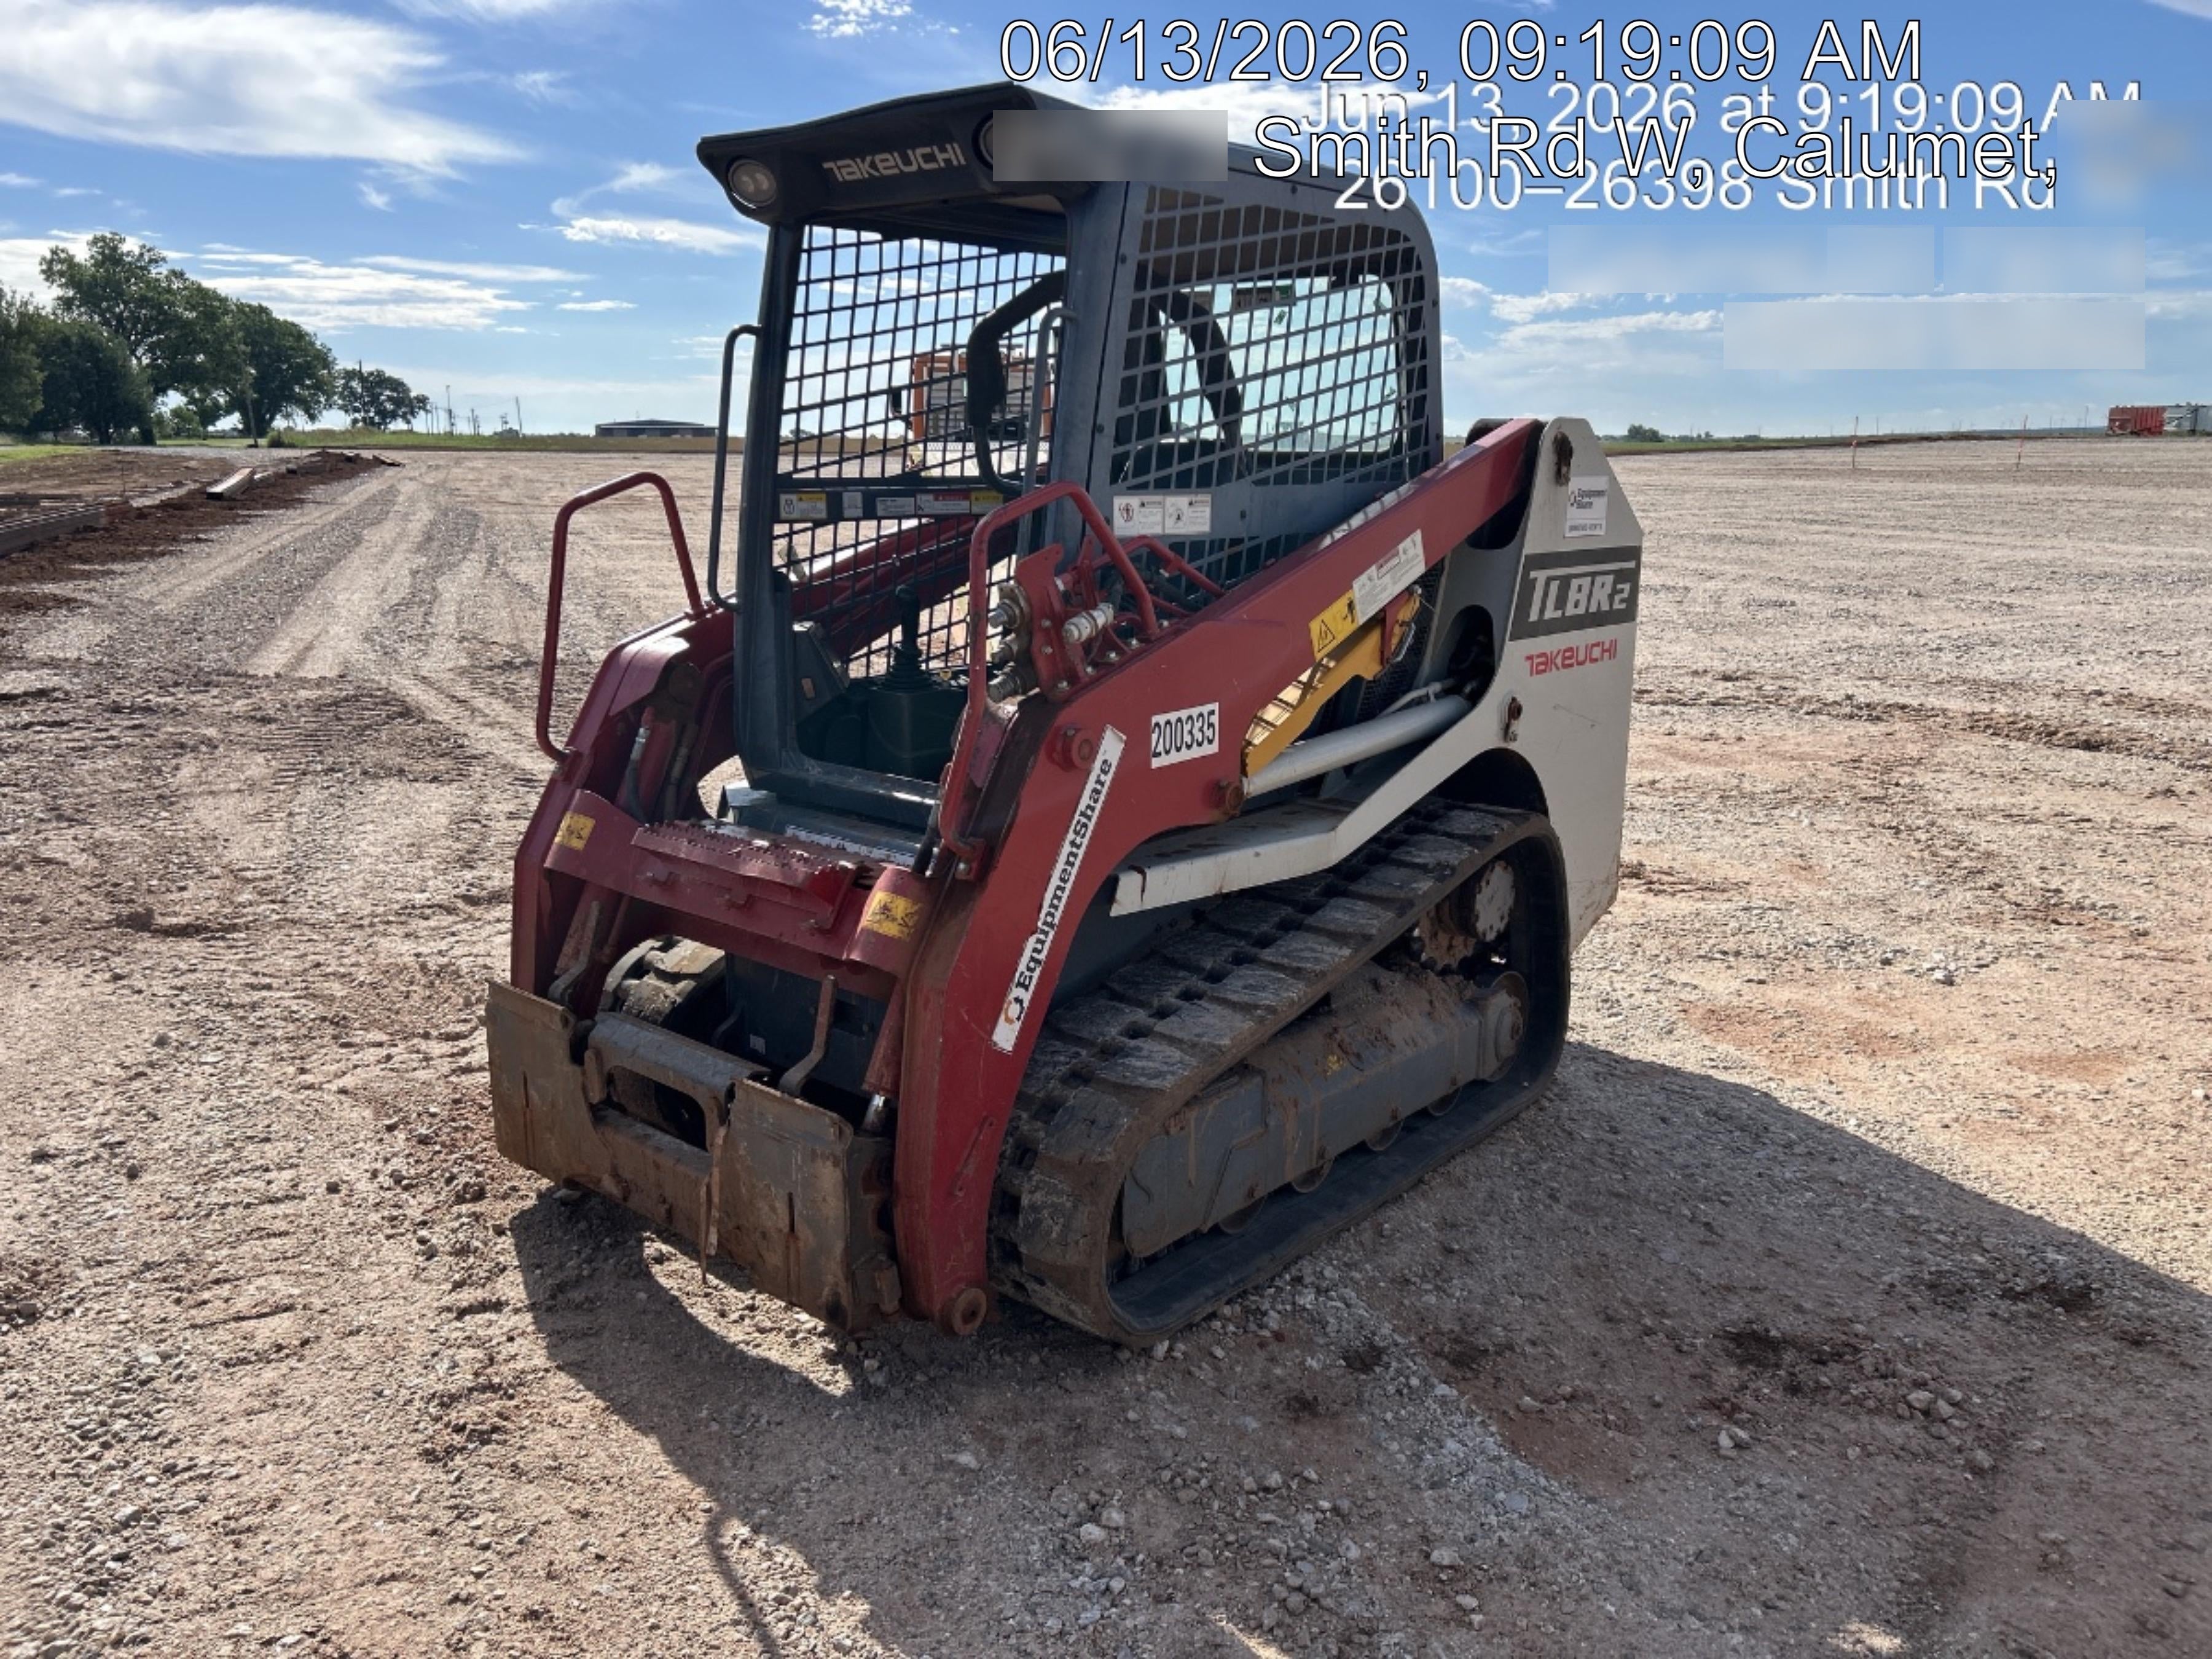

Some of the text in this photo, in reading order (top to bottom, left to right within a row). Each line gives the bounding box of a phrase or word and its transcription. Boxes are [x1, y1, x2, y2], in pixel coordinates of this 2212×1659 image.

[1528, 560, 1636, 622] TL8R2
[1151, 709, 1216, 758] 200335
[1014, 758, 1113, 992] EquipmentShare
